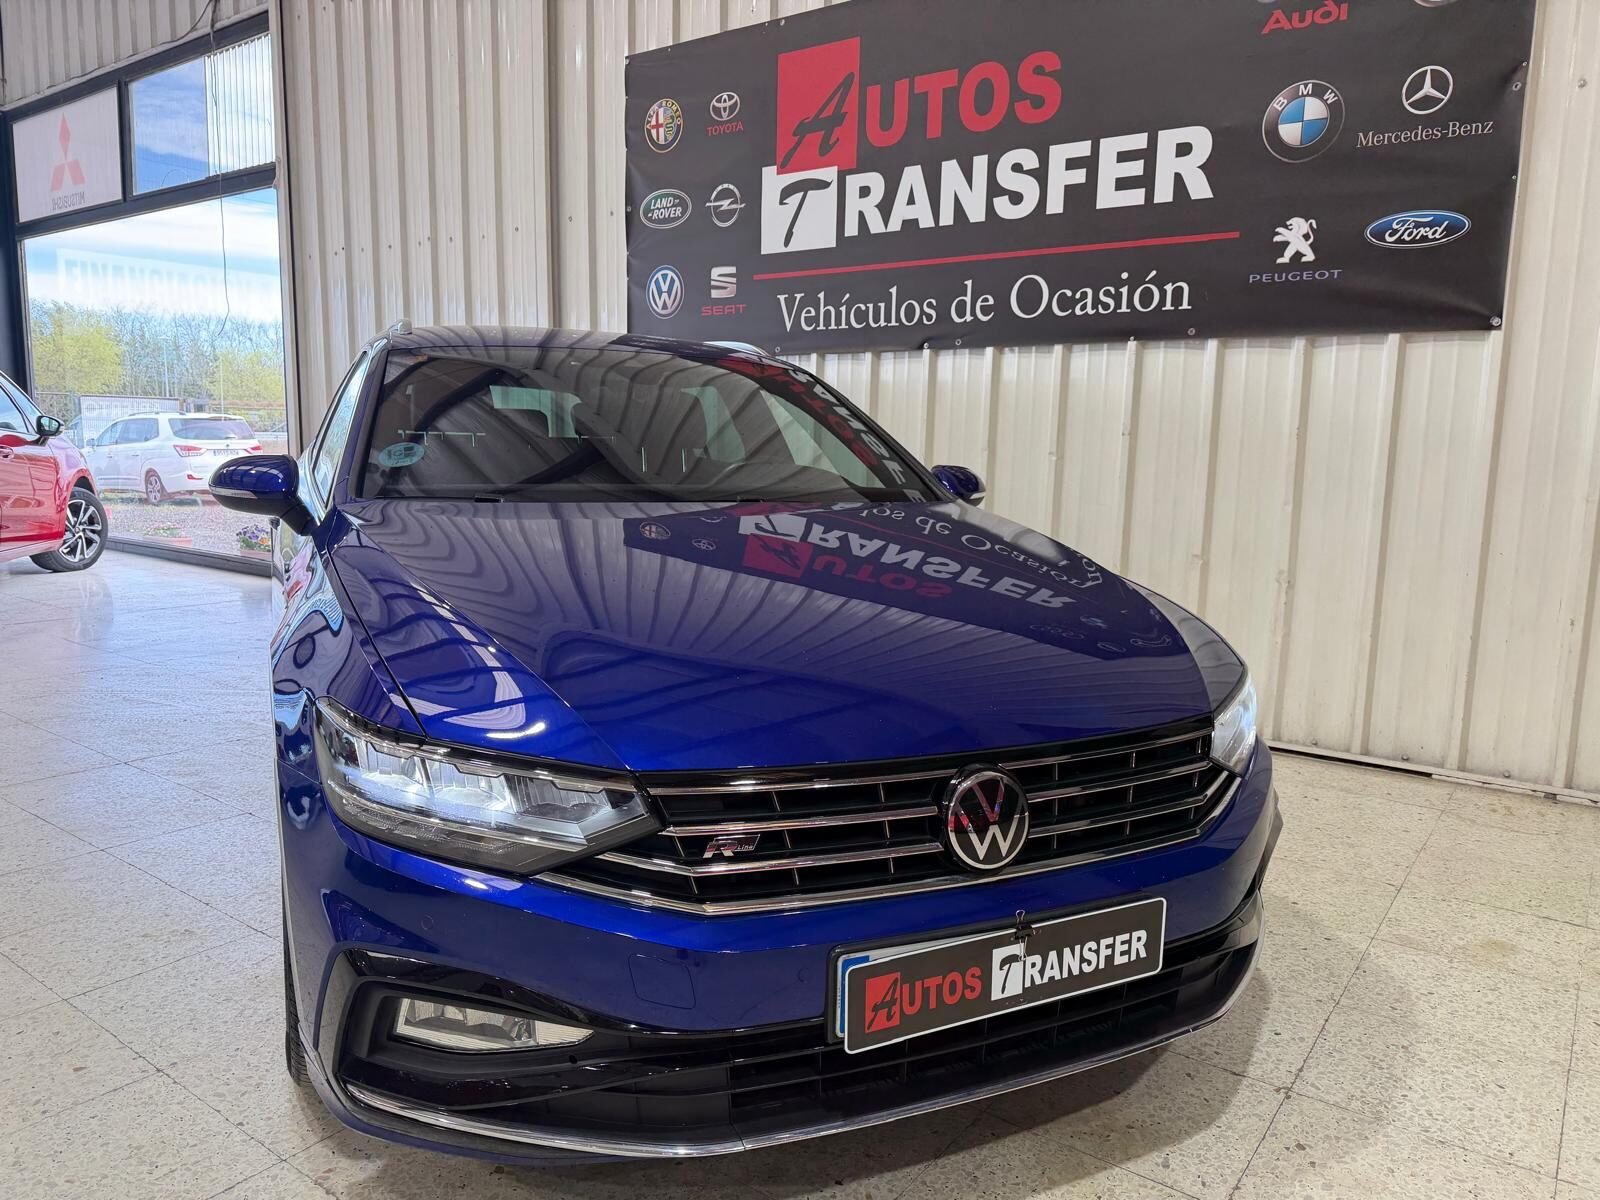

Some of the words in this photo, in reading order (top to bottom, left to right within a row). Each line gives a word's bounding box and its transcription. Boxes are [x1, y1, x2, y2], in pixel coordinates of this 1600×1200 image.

[1261, 0, 1349, 34] Audi
[780, 51, 1063, 168] AUTOS
[1274, 84, 1338, 111] BMW
[706, 121, 744, 136] TOYOTA
[1356, 120, 1494, 148] Mercedes-Benz
[780, 125, 1213, 249] TRANSFER
[650, 197, 673, 210] LAND
[652, 207, 682, 220] ROVER
[1384, 217, 1450, 241] Ford
[1249, 269, 1343, 283] PEUGEOT
[701, 303, 747, 316] SEAT
[777, 285, 937, 333] Vehículos
[949, 280, 996, 325] de
[1009, 270, 1192, 319] Ocasión
[866, 966, 983, 1033] AUTOS
[993, 929, 1147, 994] TRANSFER
